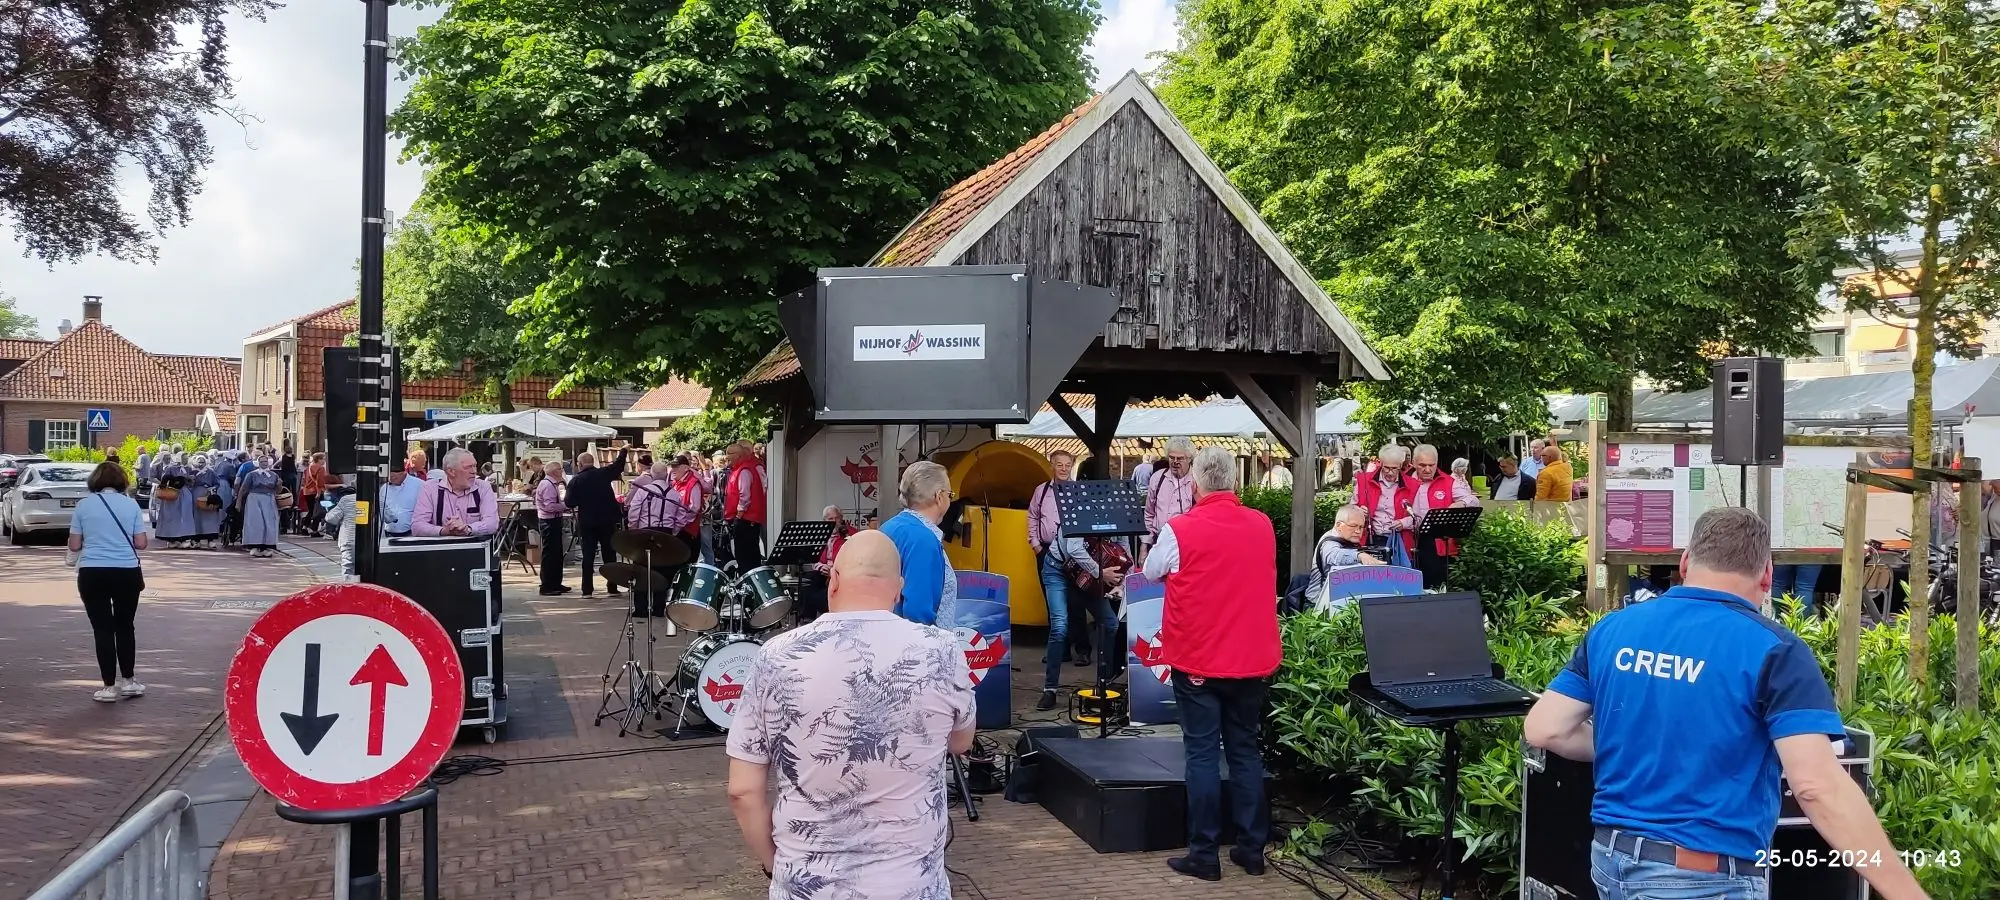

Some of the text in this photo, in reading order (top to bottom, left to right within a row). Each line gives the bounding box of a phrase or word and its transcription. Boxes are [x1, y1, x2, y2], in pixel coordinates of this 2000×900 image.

[860, 339, 901, 349] NIJHOF
[926, 337, 980, 348] WASSINK
[1331, 567, 1419, 586] Shantykoor
[1615, 647, 1705, 684] CREW
